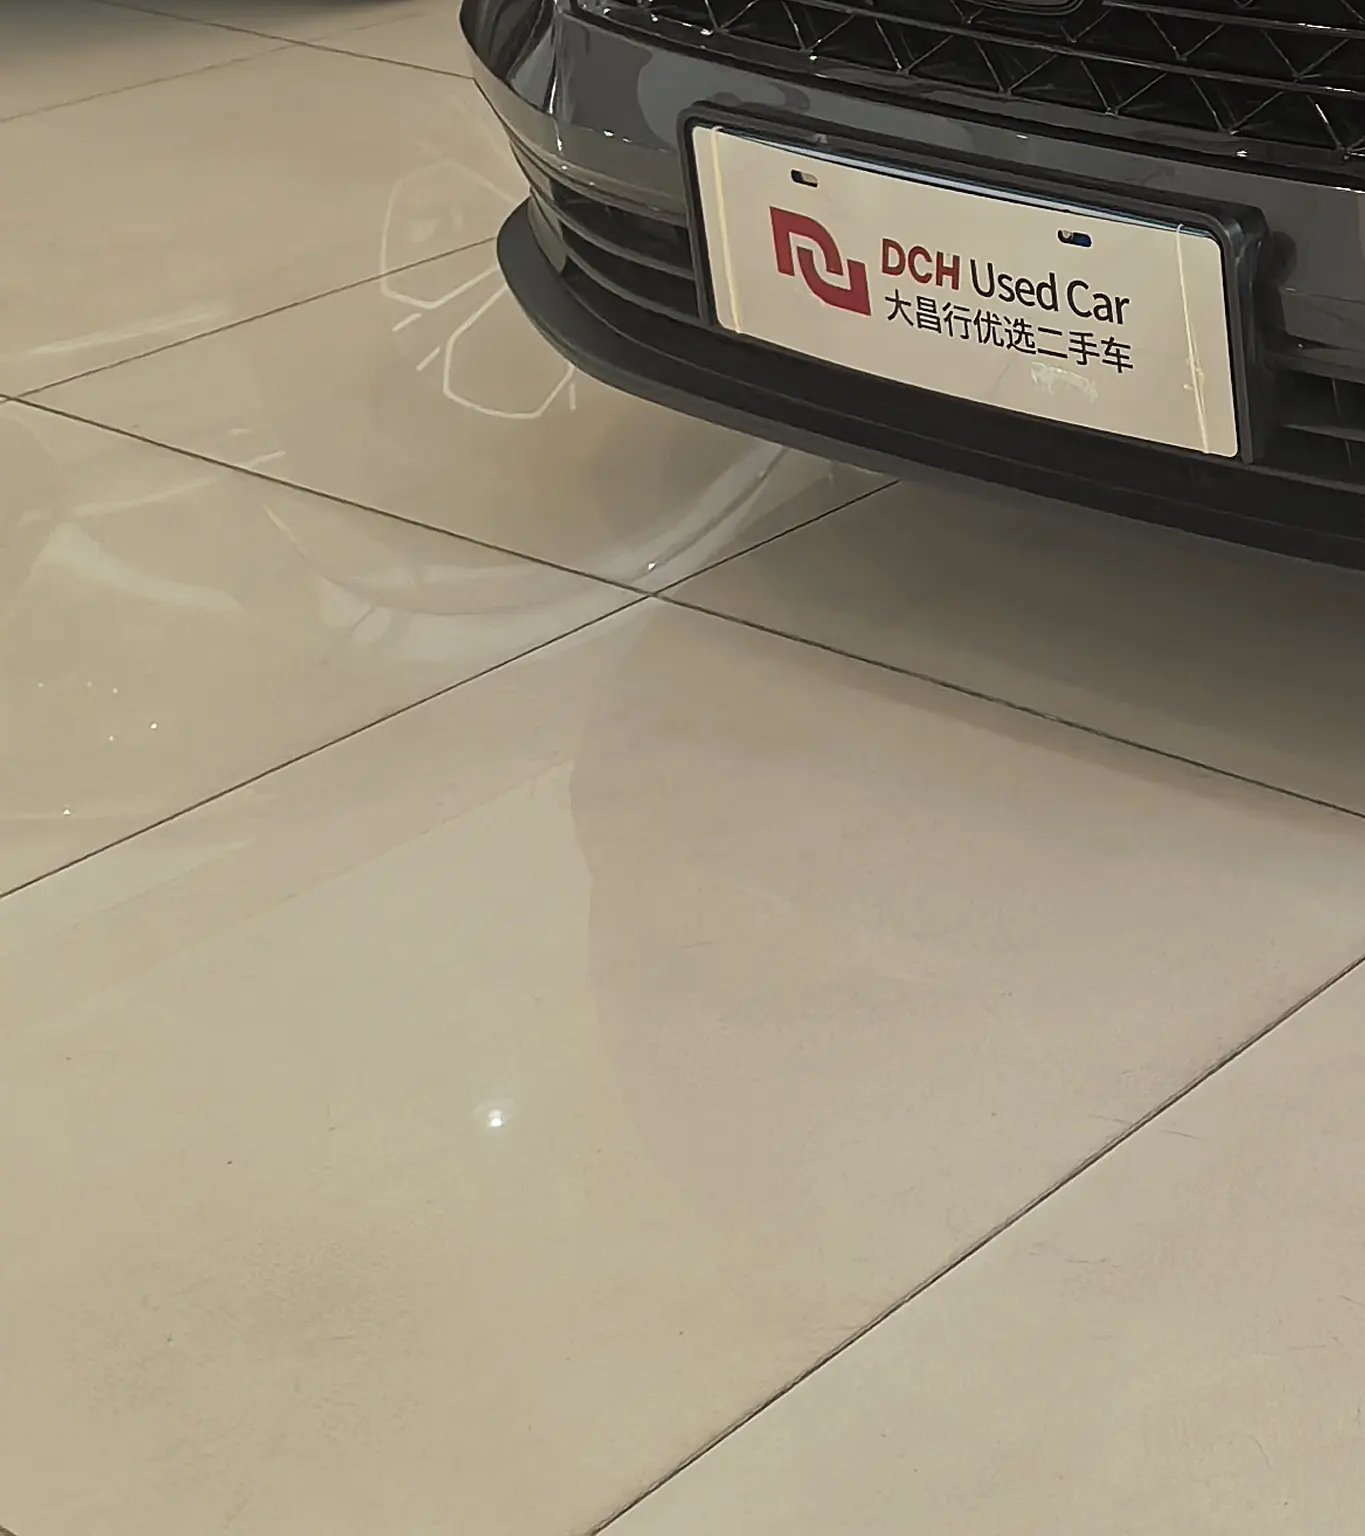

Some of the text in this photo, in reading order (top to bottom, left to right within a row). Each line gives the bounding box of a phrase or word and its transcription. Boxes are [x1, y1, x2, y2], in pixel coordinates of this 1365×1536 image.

[881, 238, 1130, 326] DCH Used Car
[885, 289, 1134, 374] 大昌行优选二手车
